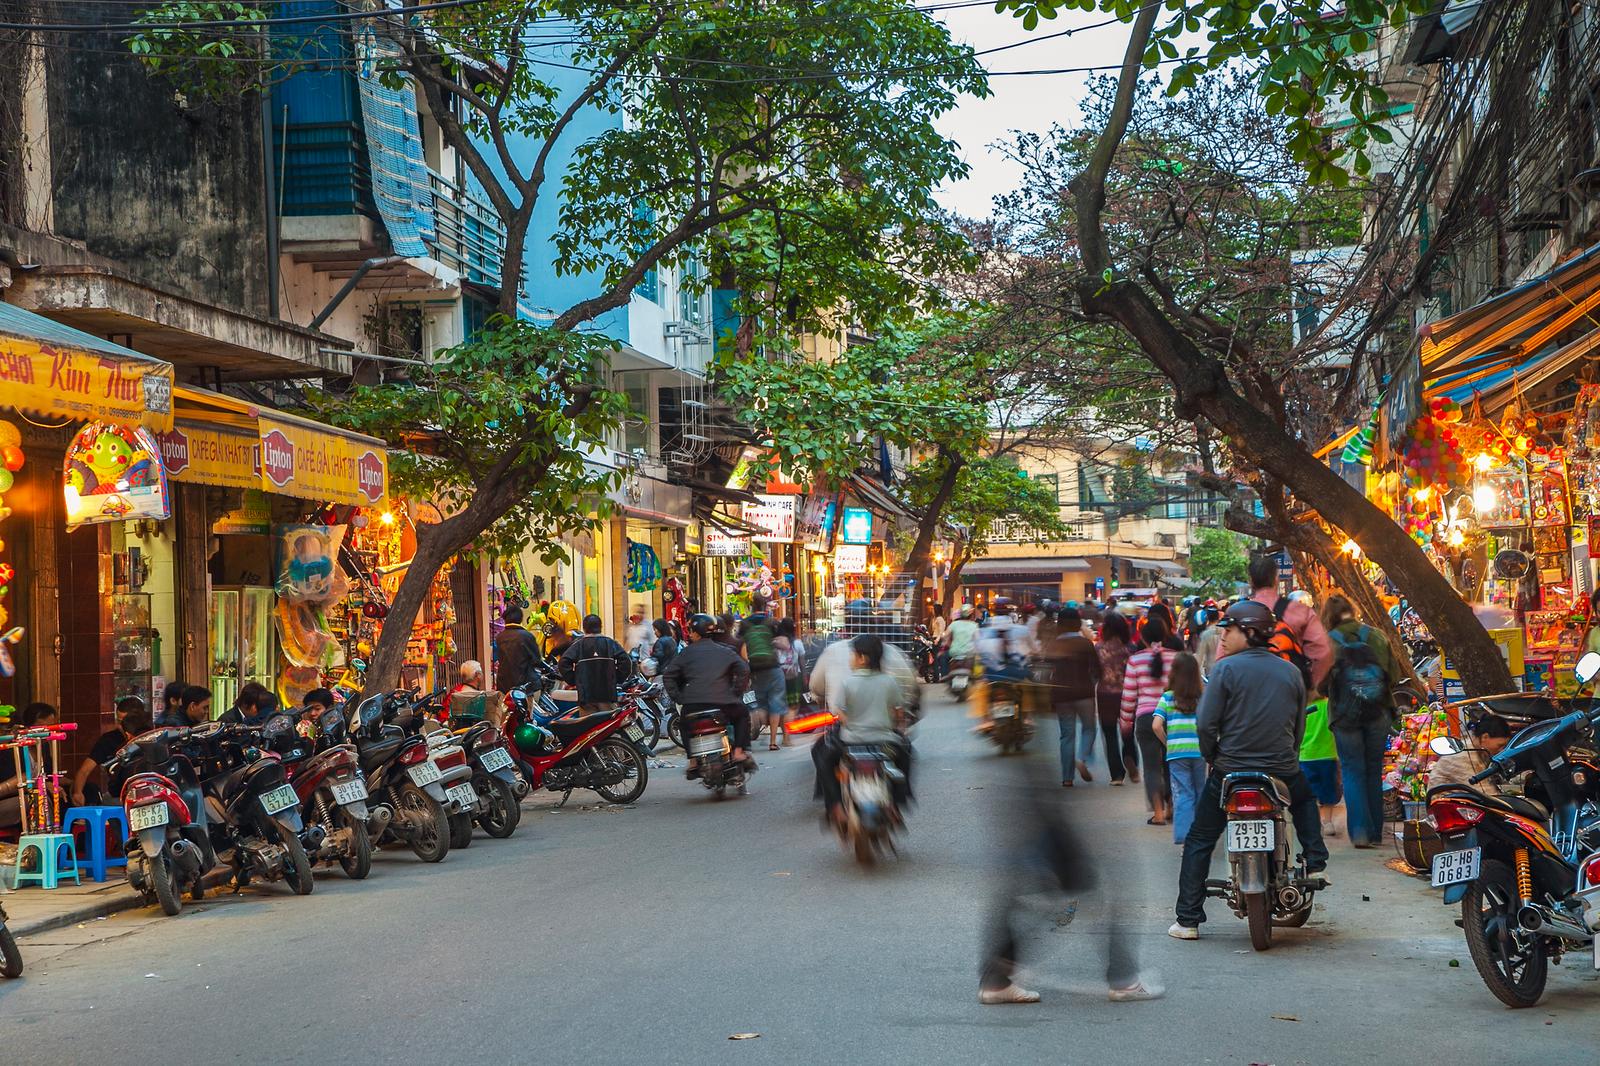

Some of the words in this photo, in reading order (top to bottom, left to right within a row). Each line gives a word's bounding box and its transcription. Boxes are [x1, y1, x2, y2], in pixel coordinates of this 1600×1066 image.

[158, 436, 187, 464] ipton
[263, 440, 292, 473] Lipton
[359, 463, 384, 490] Lipton
[336, 782, 360, 794] 30-F4
[340, 790, 364, 803] 5160
[137, 814, 163, 829] 2093
[1235, 822, 1267, 836] 29-U5
[1236, 836, 1268, 849] 1233
[1439, 850, 1473, 870] 30-H8
[1438, 865, 1472, 884] 0683
